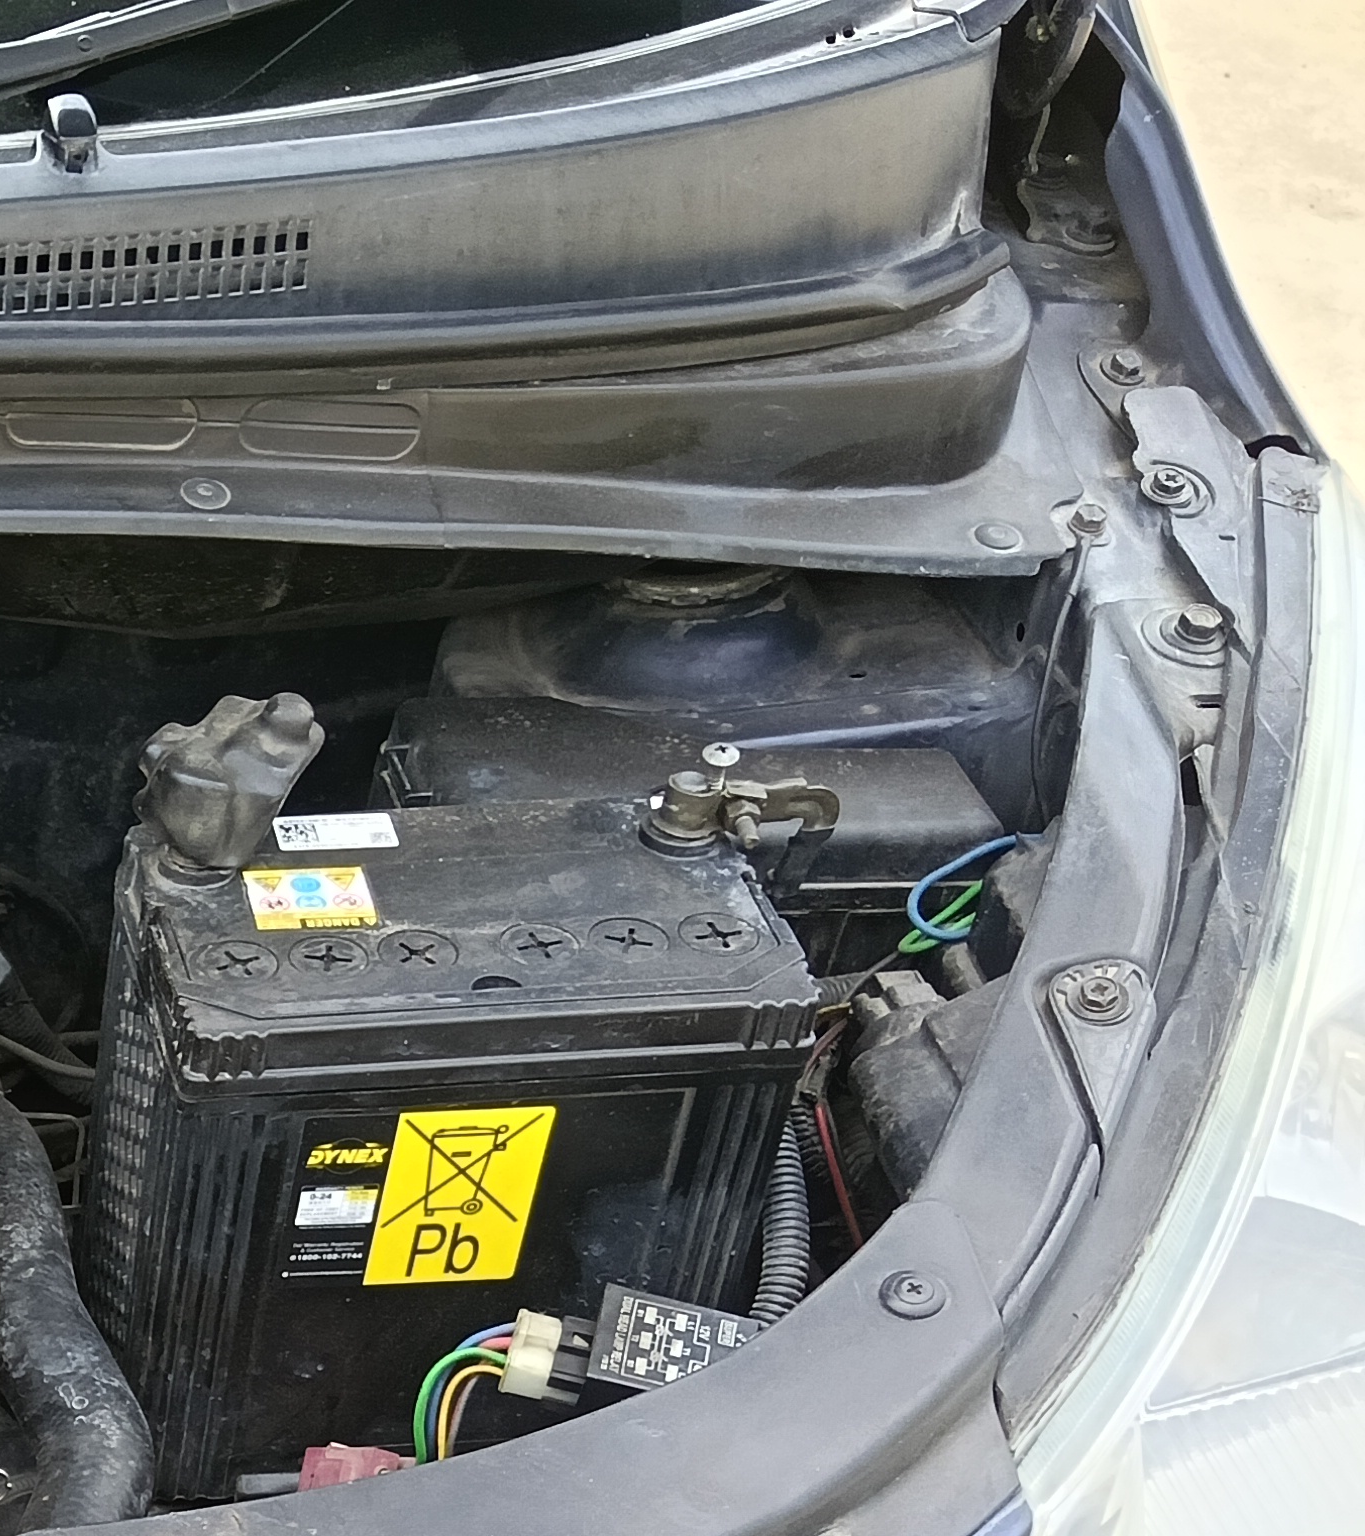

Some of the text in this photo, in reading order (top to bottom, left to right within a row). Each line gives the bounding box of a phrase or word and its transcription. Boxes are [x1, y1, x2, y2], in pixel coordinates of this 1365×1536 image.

[304, 917, 360, 928] DANGER
[306, 1146, 389, 1165] DYNEX
[405, 1222, 479, 1277] Pb
[617, 1314, 630, 1332] HEAD
[613, 1332, 625, 1350] LAMP
[699, 1325, 711, 1341] 12V
[610, 1350, 623, 1374] RELAY
